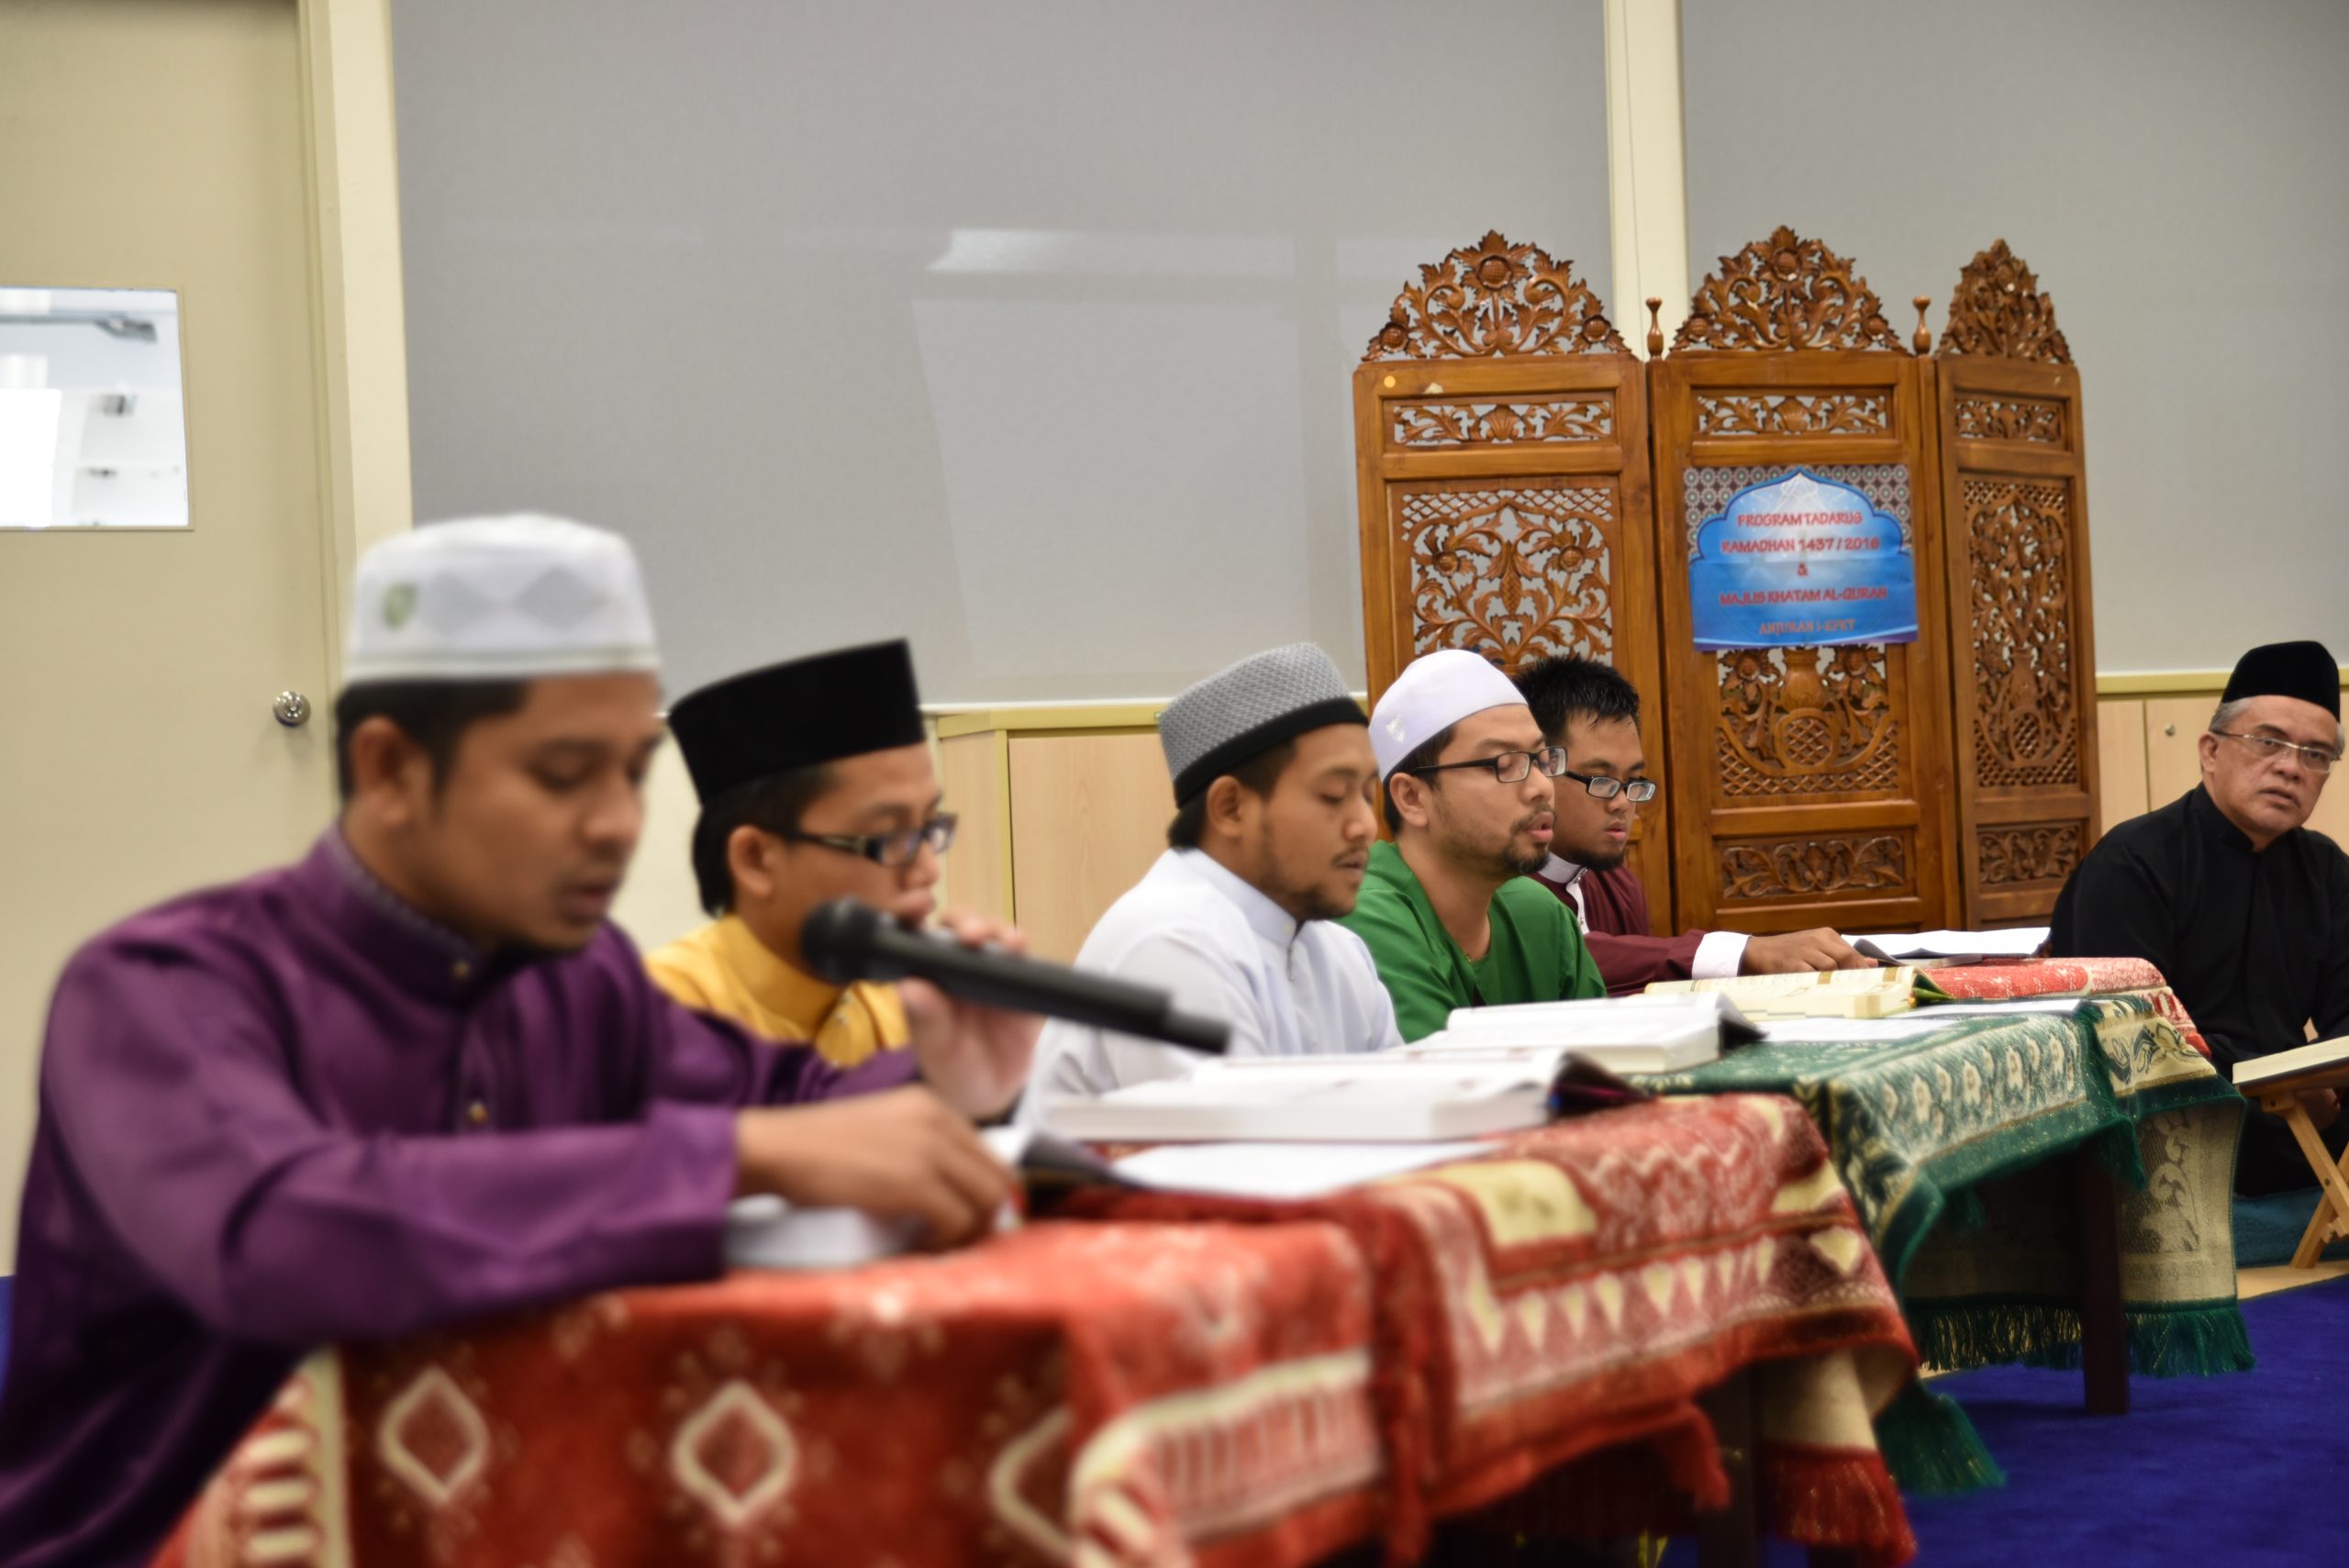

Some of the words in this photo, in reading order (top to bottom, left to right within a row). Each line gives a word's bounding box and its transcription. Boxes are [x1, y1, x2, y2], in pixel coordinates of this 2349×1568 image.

[1738, 513, 1801, 527] PROGRAM
[1804, 511, 1863, 525] TADARUS
[1721, 539, 1795, 552] RAMADHAN
[1798, 538, 1834, 551] 1437
[1844, 537, 1880, 550] 2016
[1798, 562, 1808, 576] &
[1720, 593, 1765, 606] MAJLIS
[1767, 589, 1820, 603] KHATAM
